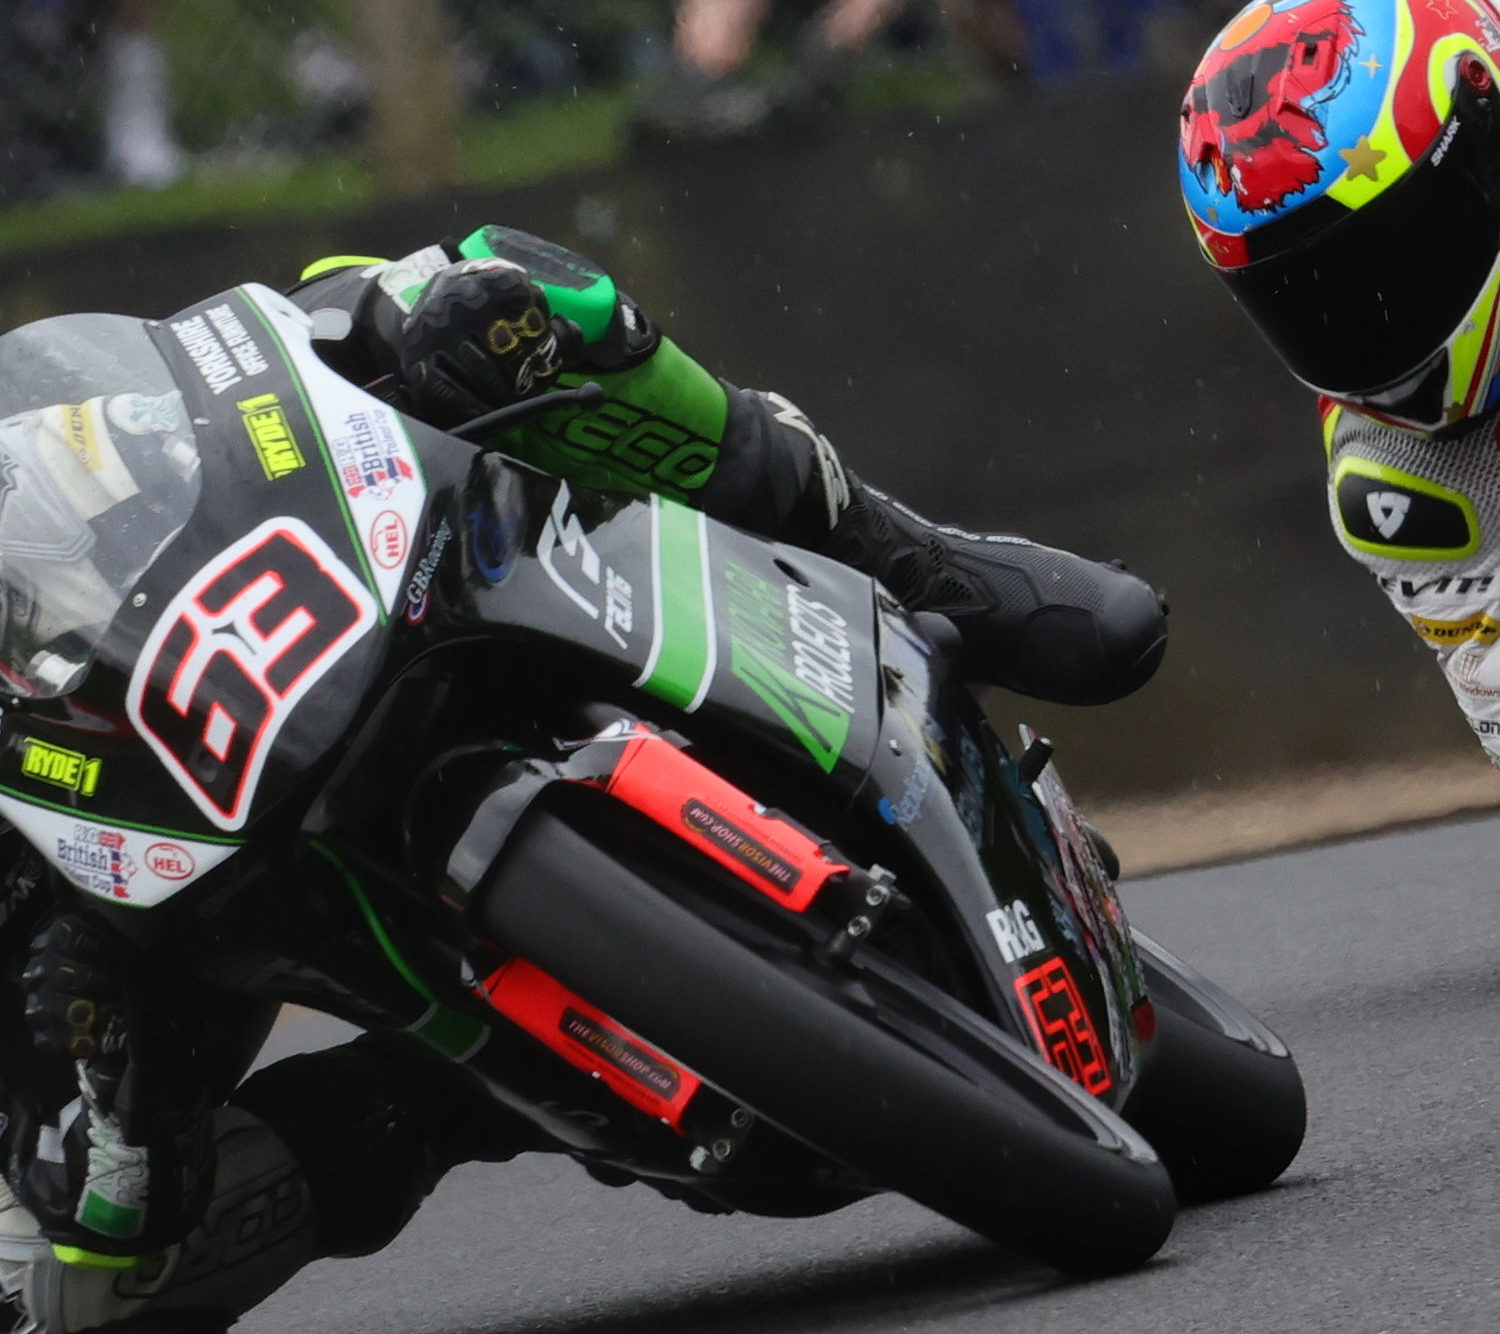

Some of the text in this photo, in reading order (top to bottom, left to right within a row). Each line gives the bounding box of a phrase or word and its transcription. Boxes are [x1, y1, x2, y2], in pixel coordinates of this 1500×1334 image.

[1431, 116, 1461, 167] SHARK
[170, 314, 242, 396] YORKSHIRE
[205, 303, 269, 377] OFFICE FURNITURE
[235, 392, 305, 481] RYDE 1
[345, 411, 384, 474] British
[385, 519, 400, 560] HEL
[604, 565, 633, 650] racing
[726, 560, 787, 661] KOVARA
[139, 528, 364, 820] 63
[786, 583, 856, 714] PROJECTS
[26, 744, 103, 798] RYDE 1
[57, 837, 111, 872] British
[153, 856, 187, 875] HEL
[690, 804, 793, 884] THEVISORSHOP.COM
[568, 1018, 673, 1091] THEVISORSHOP.COM
